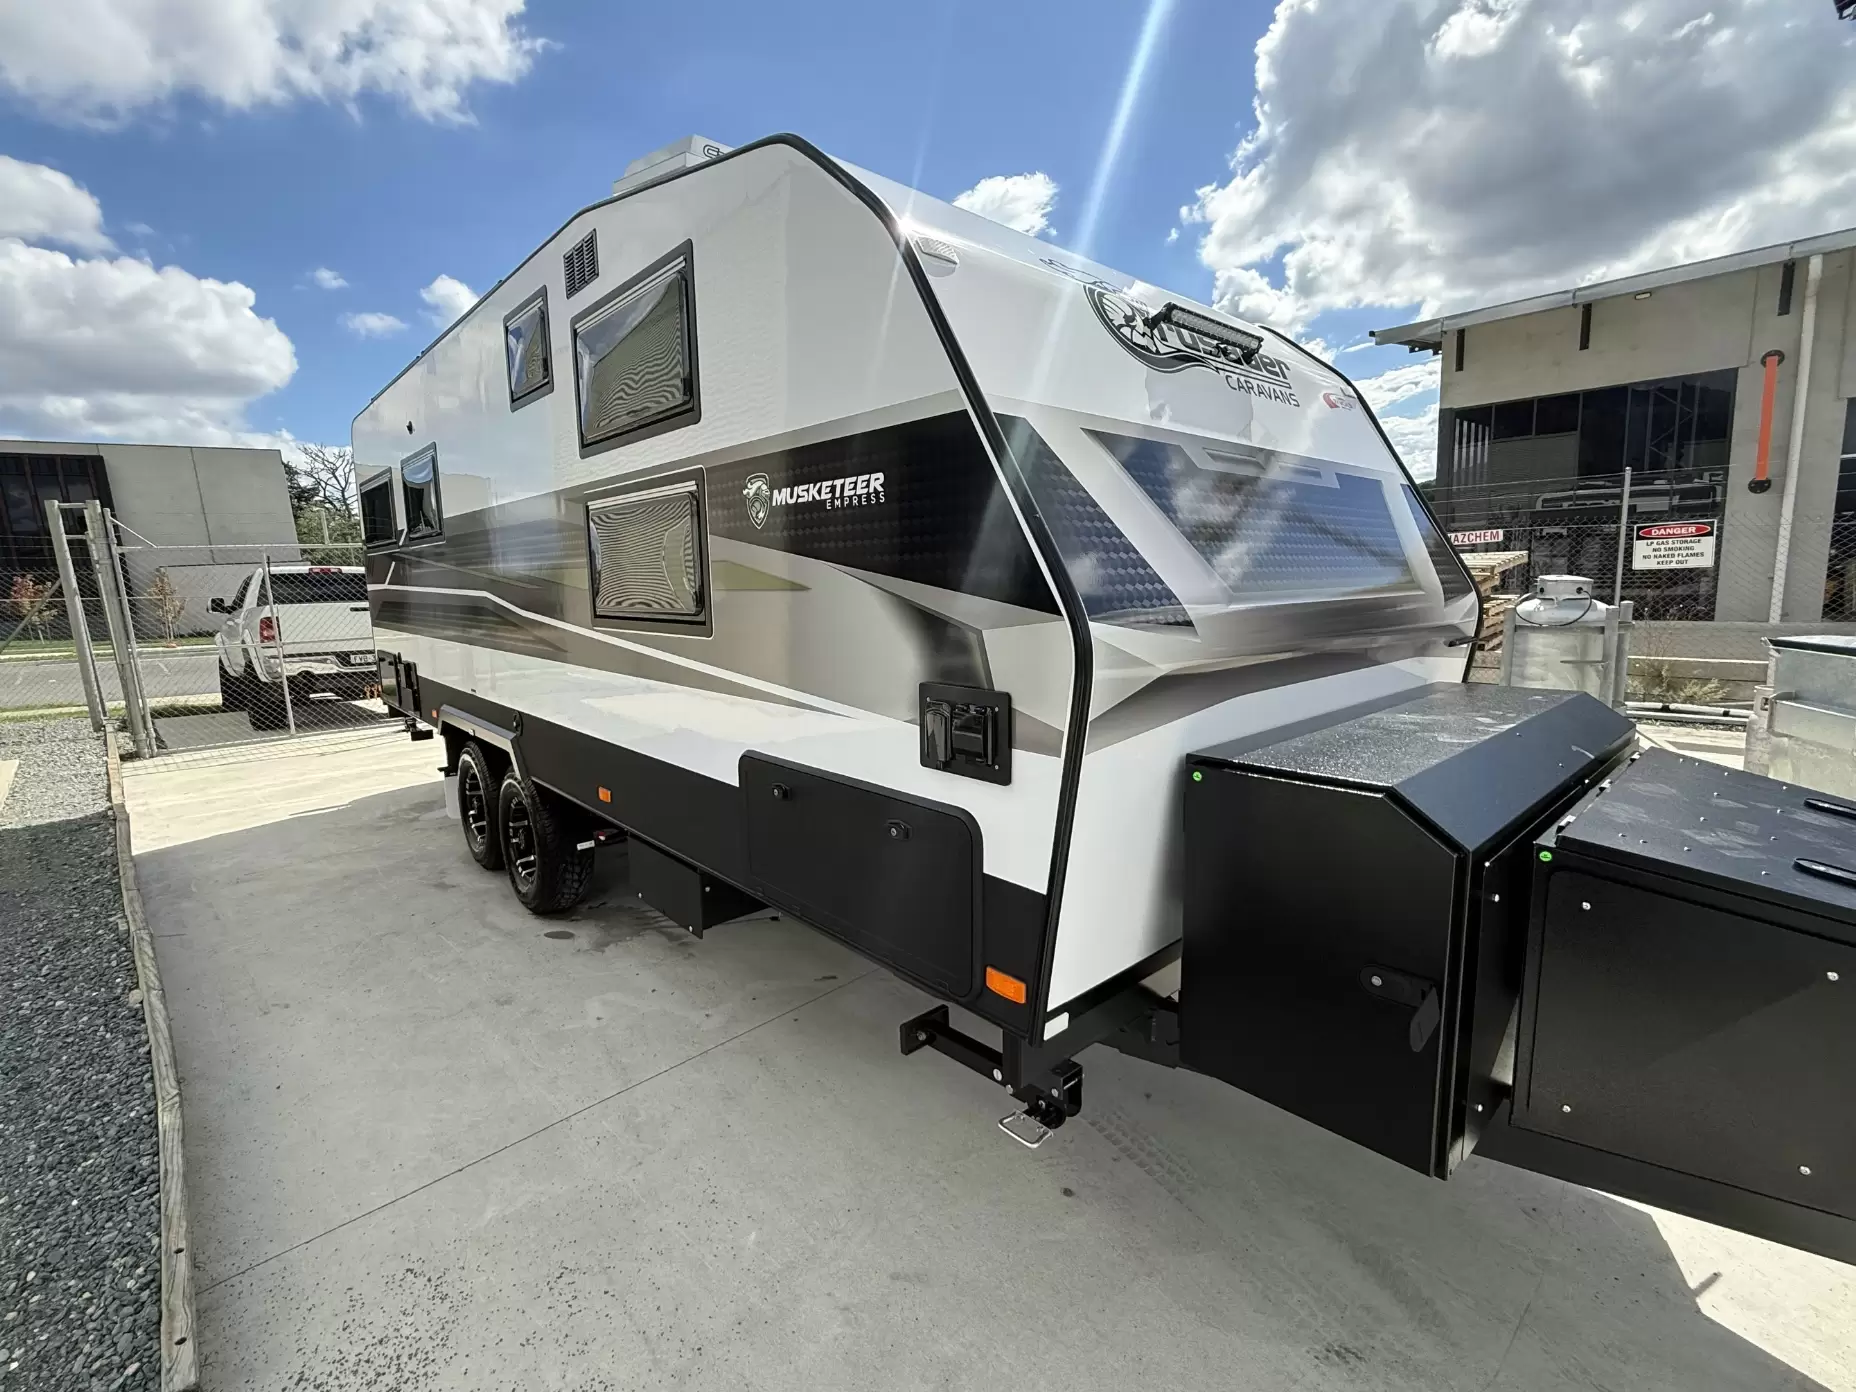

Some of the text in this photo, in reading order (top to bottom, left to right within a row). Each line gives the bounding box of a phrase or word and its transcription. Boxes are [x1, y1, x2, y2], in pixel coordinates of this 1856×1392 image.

[1225, 375, 1300, 407] CARAVANS
[772, 472, 885, 506] MUSKETEER
[826, 492, 885, 509] EMPRESS
[1652, 526, 1696, 536] DANGER
